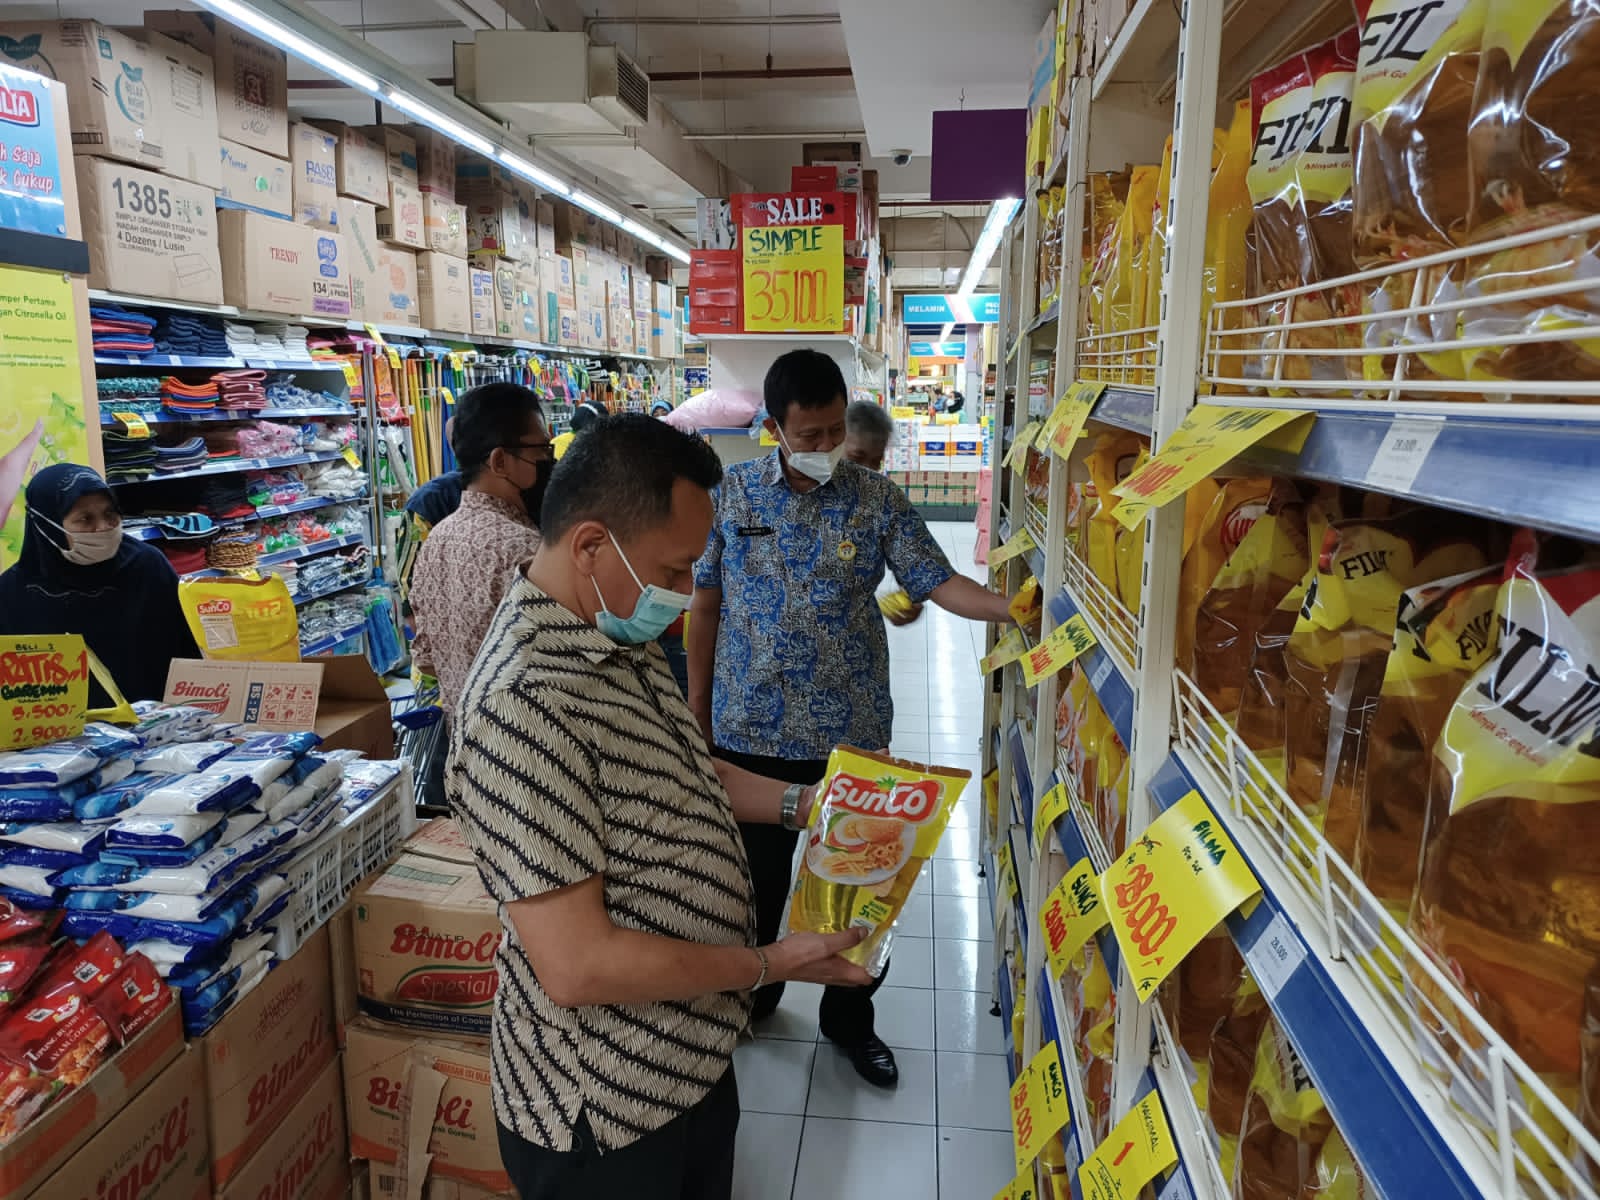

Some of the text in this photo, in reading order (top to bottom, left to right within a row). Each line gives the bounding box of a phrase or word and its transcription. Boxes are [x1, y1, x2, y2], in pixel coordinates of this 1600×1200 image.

[13, 170, 54, 193] Cukup
[112, 177, 172, 219] 1385
[766, 197, 824, 225] SALE
[124, 231, 158, 249] Dozens
[163, 240, 186, 252] Lusin
[749, 226, 823, 253] SIMPLE
[271, 247, 299, 265] TRENDY
[312, 281, 328, 295] 134
[23, 295, 57, 307] Pertama
[908, 305, 946, 313] MELAMIN
[14, 308, 54, 321] Citronella
[55, 311, 67, 321] Oil
[198, 600, 231, 615] SunCo
[171, 681, 231, 699] Bimoli
[831, 777, 928, 815] SunCo
[1191, 819, 1228, 867] FILMA
[390, 923, 503, 963] Bimoli
[419, 973, 494, 1001] Spesial
[461, 1015, 493, 1027] Cookin
[246, 1006, 324, 1127] Bimoli
[1112, 1140, 1136, 1167] 1
